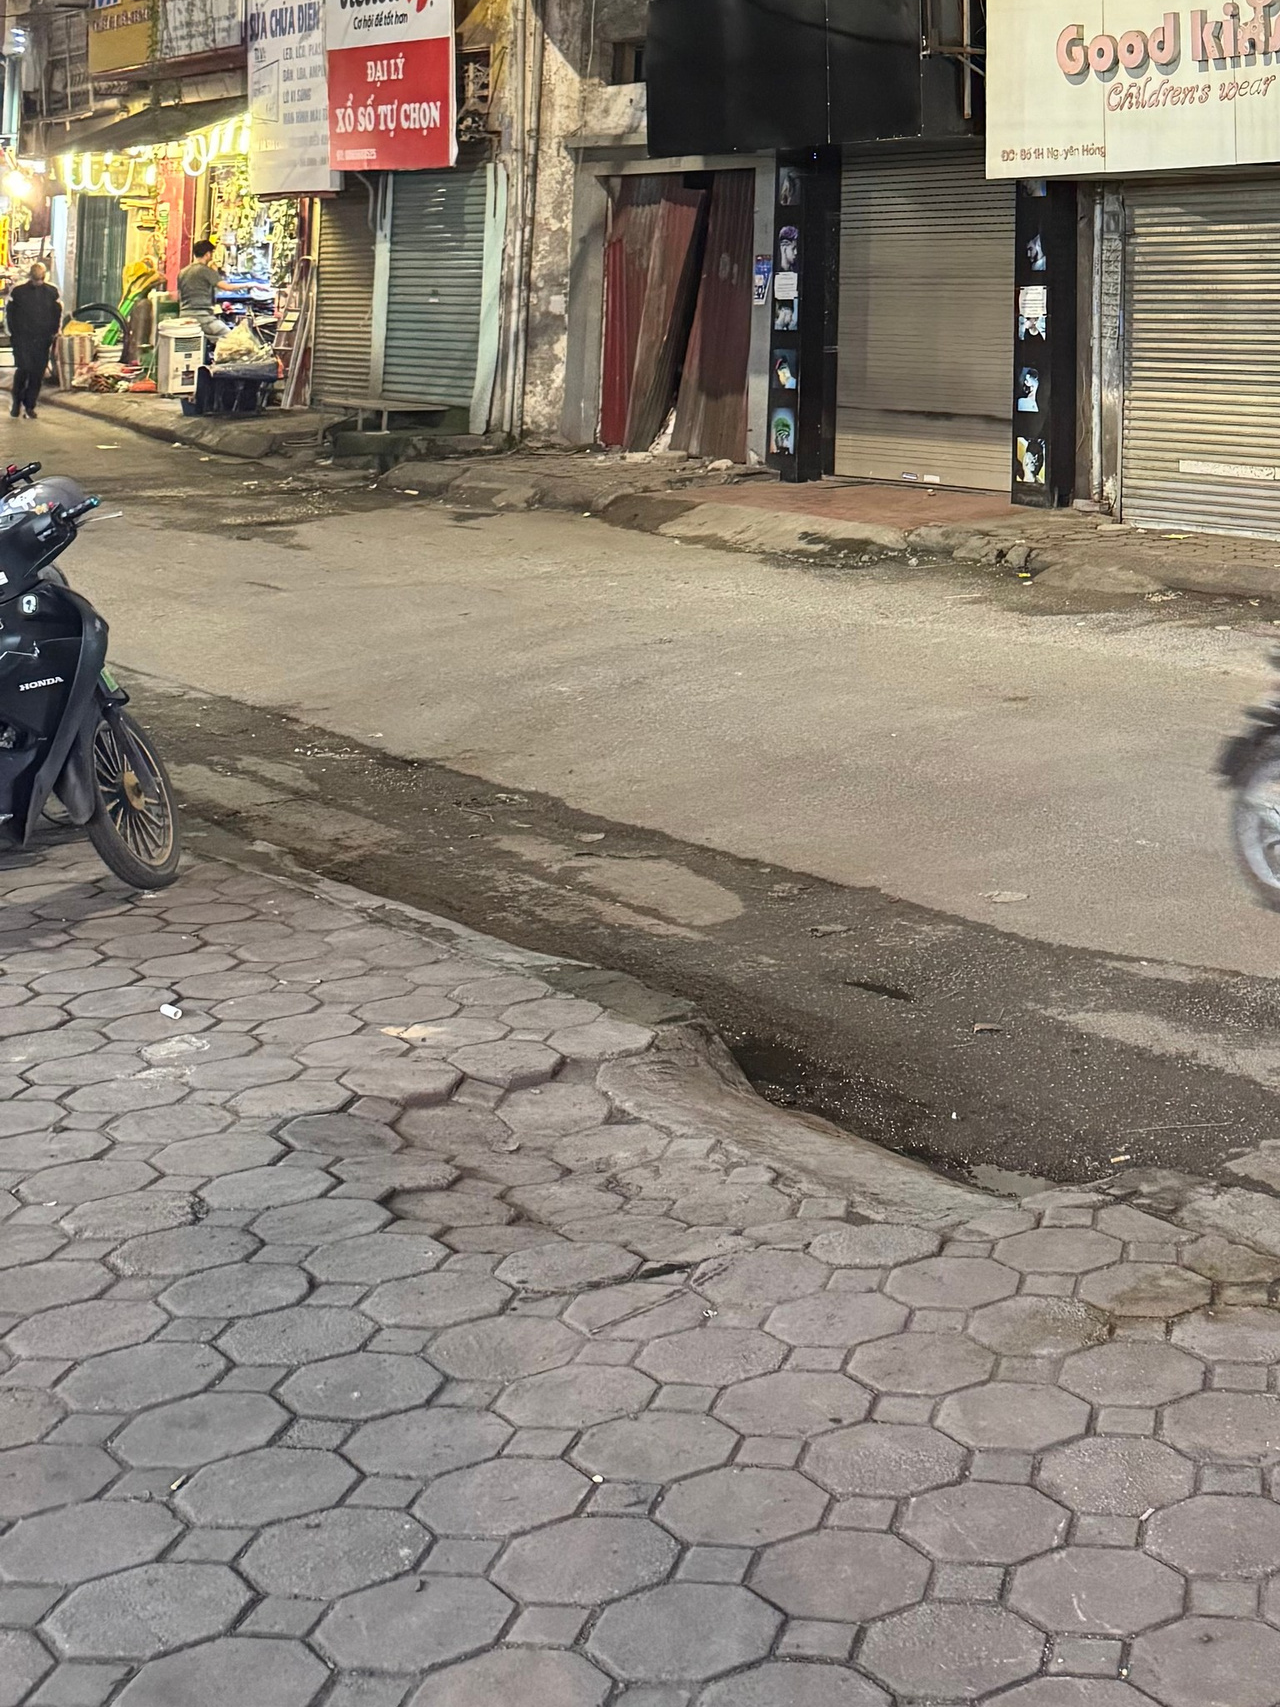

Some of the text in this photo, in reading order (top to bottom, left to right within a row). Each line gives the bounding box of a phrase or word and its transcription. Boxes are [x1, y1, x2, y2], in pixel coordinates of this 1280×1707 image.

[1056, 13, 1180, 75] Good
[367, 52, 405, 87] ĐẠI LÝ
[1106, 75, 1276, 112] Children's wear
[335, 93, 441, 137] XỔ SỐ TỰ CHỌN
[19, 676, 64, 692] HONDA
